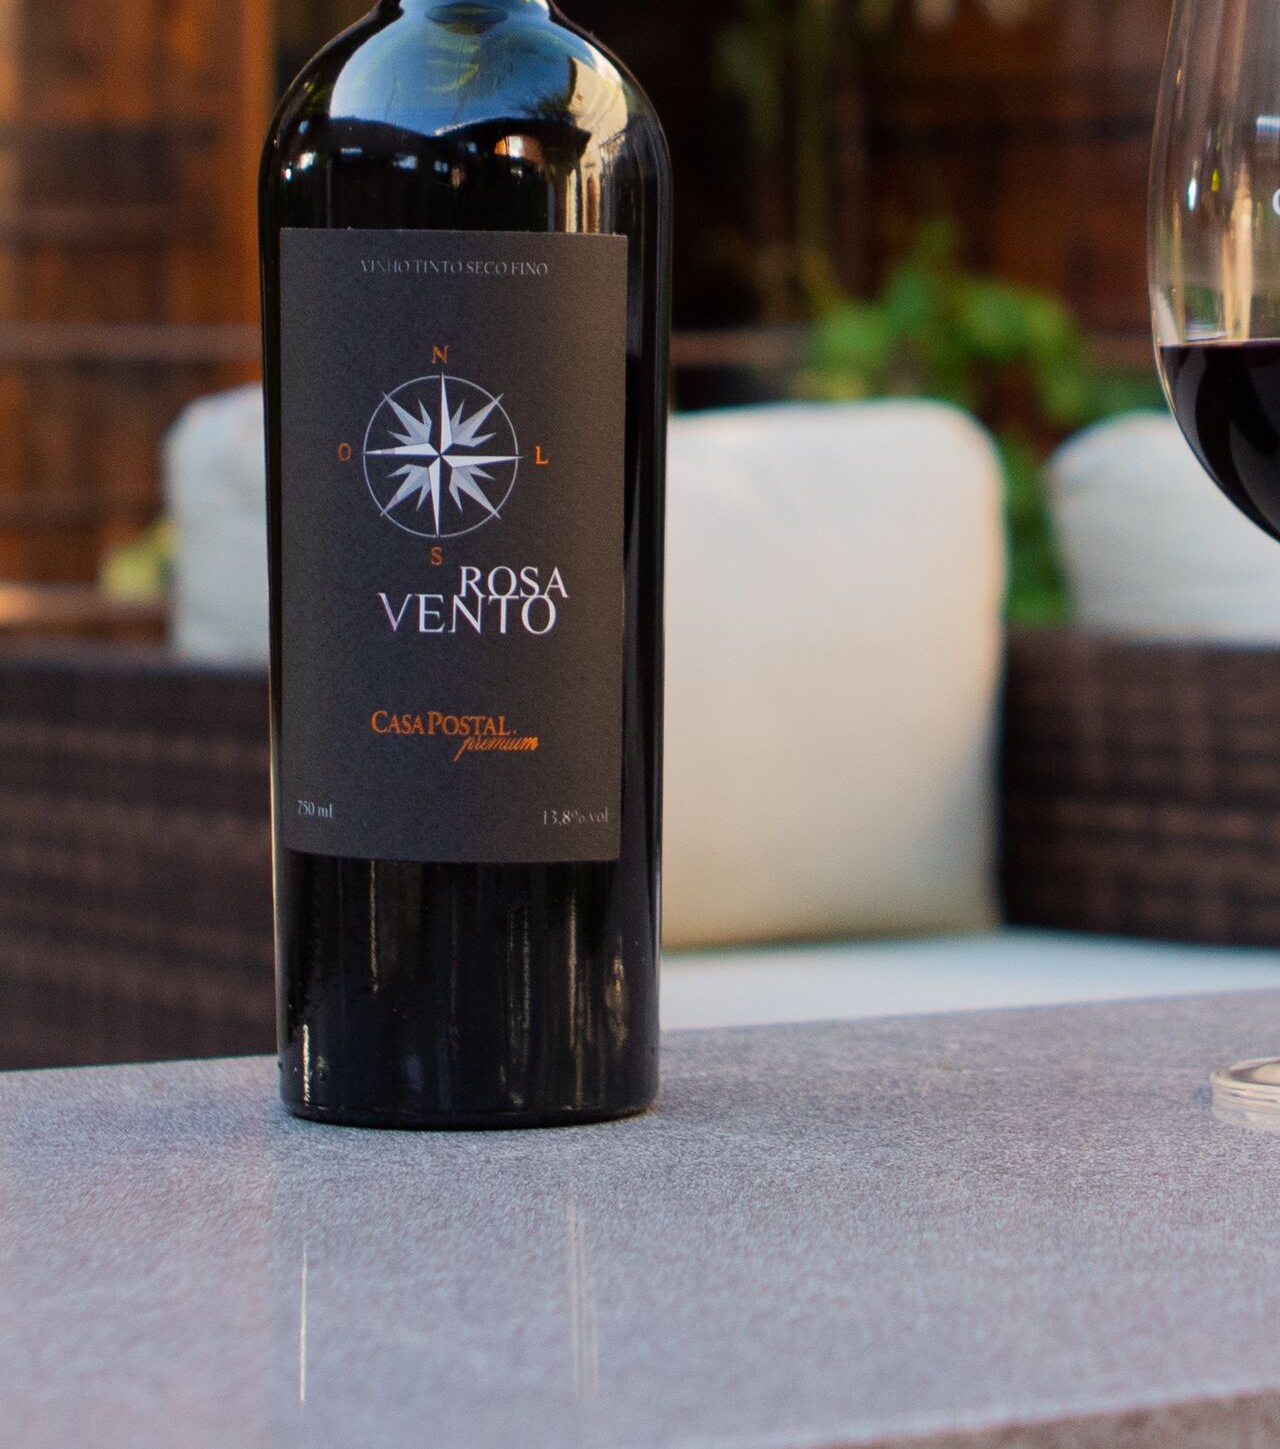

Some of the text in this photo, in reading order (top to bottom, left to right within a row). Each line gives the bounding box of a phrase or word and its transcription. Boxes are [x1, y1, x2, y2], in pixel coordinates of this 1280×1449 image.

[360, 259, 549, 276] VINHO TINTO SECO FINO
[431, 345, 449, 364] N
[337, 443, 352, 461] O
[534, 446, 550, 465] L
[430, 546, 444, 566] S
[459, 565, 570, 598] ROSA
[377, 592, 558, 635] VENTO
[454, 735, 539, 762] premium
[297, 799, 333, 819] 750 ml
